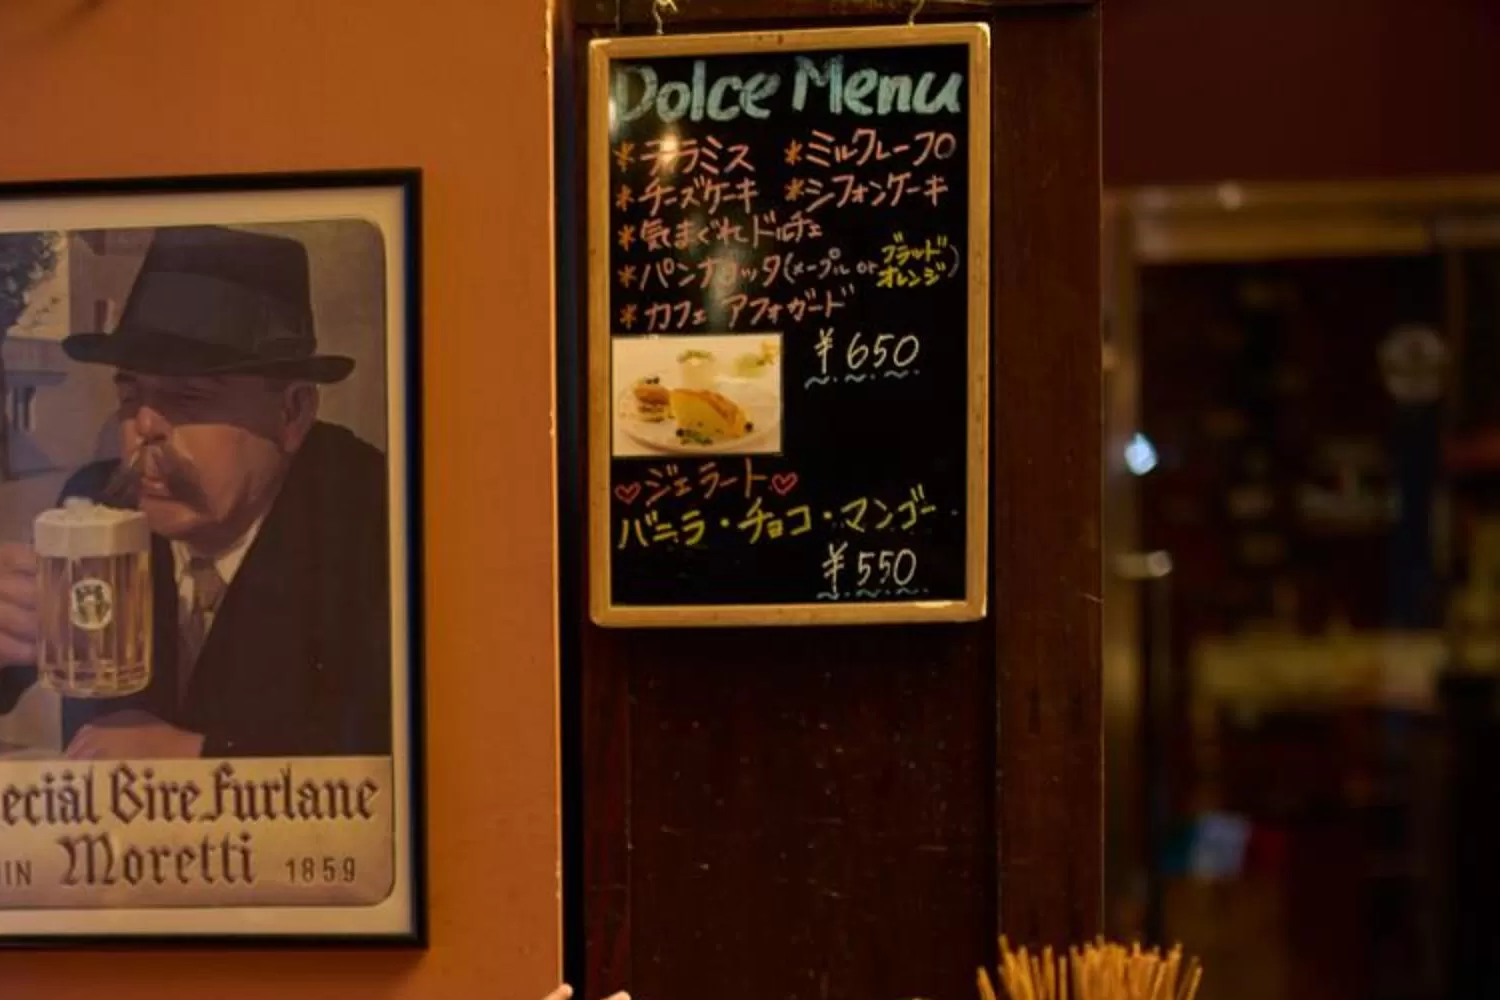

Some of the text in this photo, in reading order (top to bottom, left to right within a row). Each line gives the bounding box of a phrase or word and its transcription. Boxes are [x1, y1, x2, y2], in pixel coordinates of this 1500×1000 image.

[613, 54, 963, 122] Dolce Menu
[639, 135, 756, 176] テラミス
[805, 127, 957, 167] ミルクレープ
[637, 175, 759, 217] チーズケーキ
[804, 172, 949, 213] シフォンケーキ
[813, 327, 920, 374] ¥650
[821, 541, 917, 592] ¥550
[110, 762, 200, 824] Bire
[56, 831, 257, 886] Moretti
[285, 855, 357, 885] 1859
